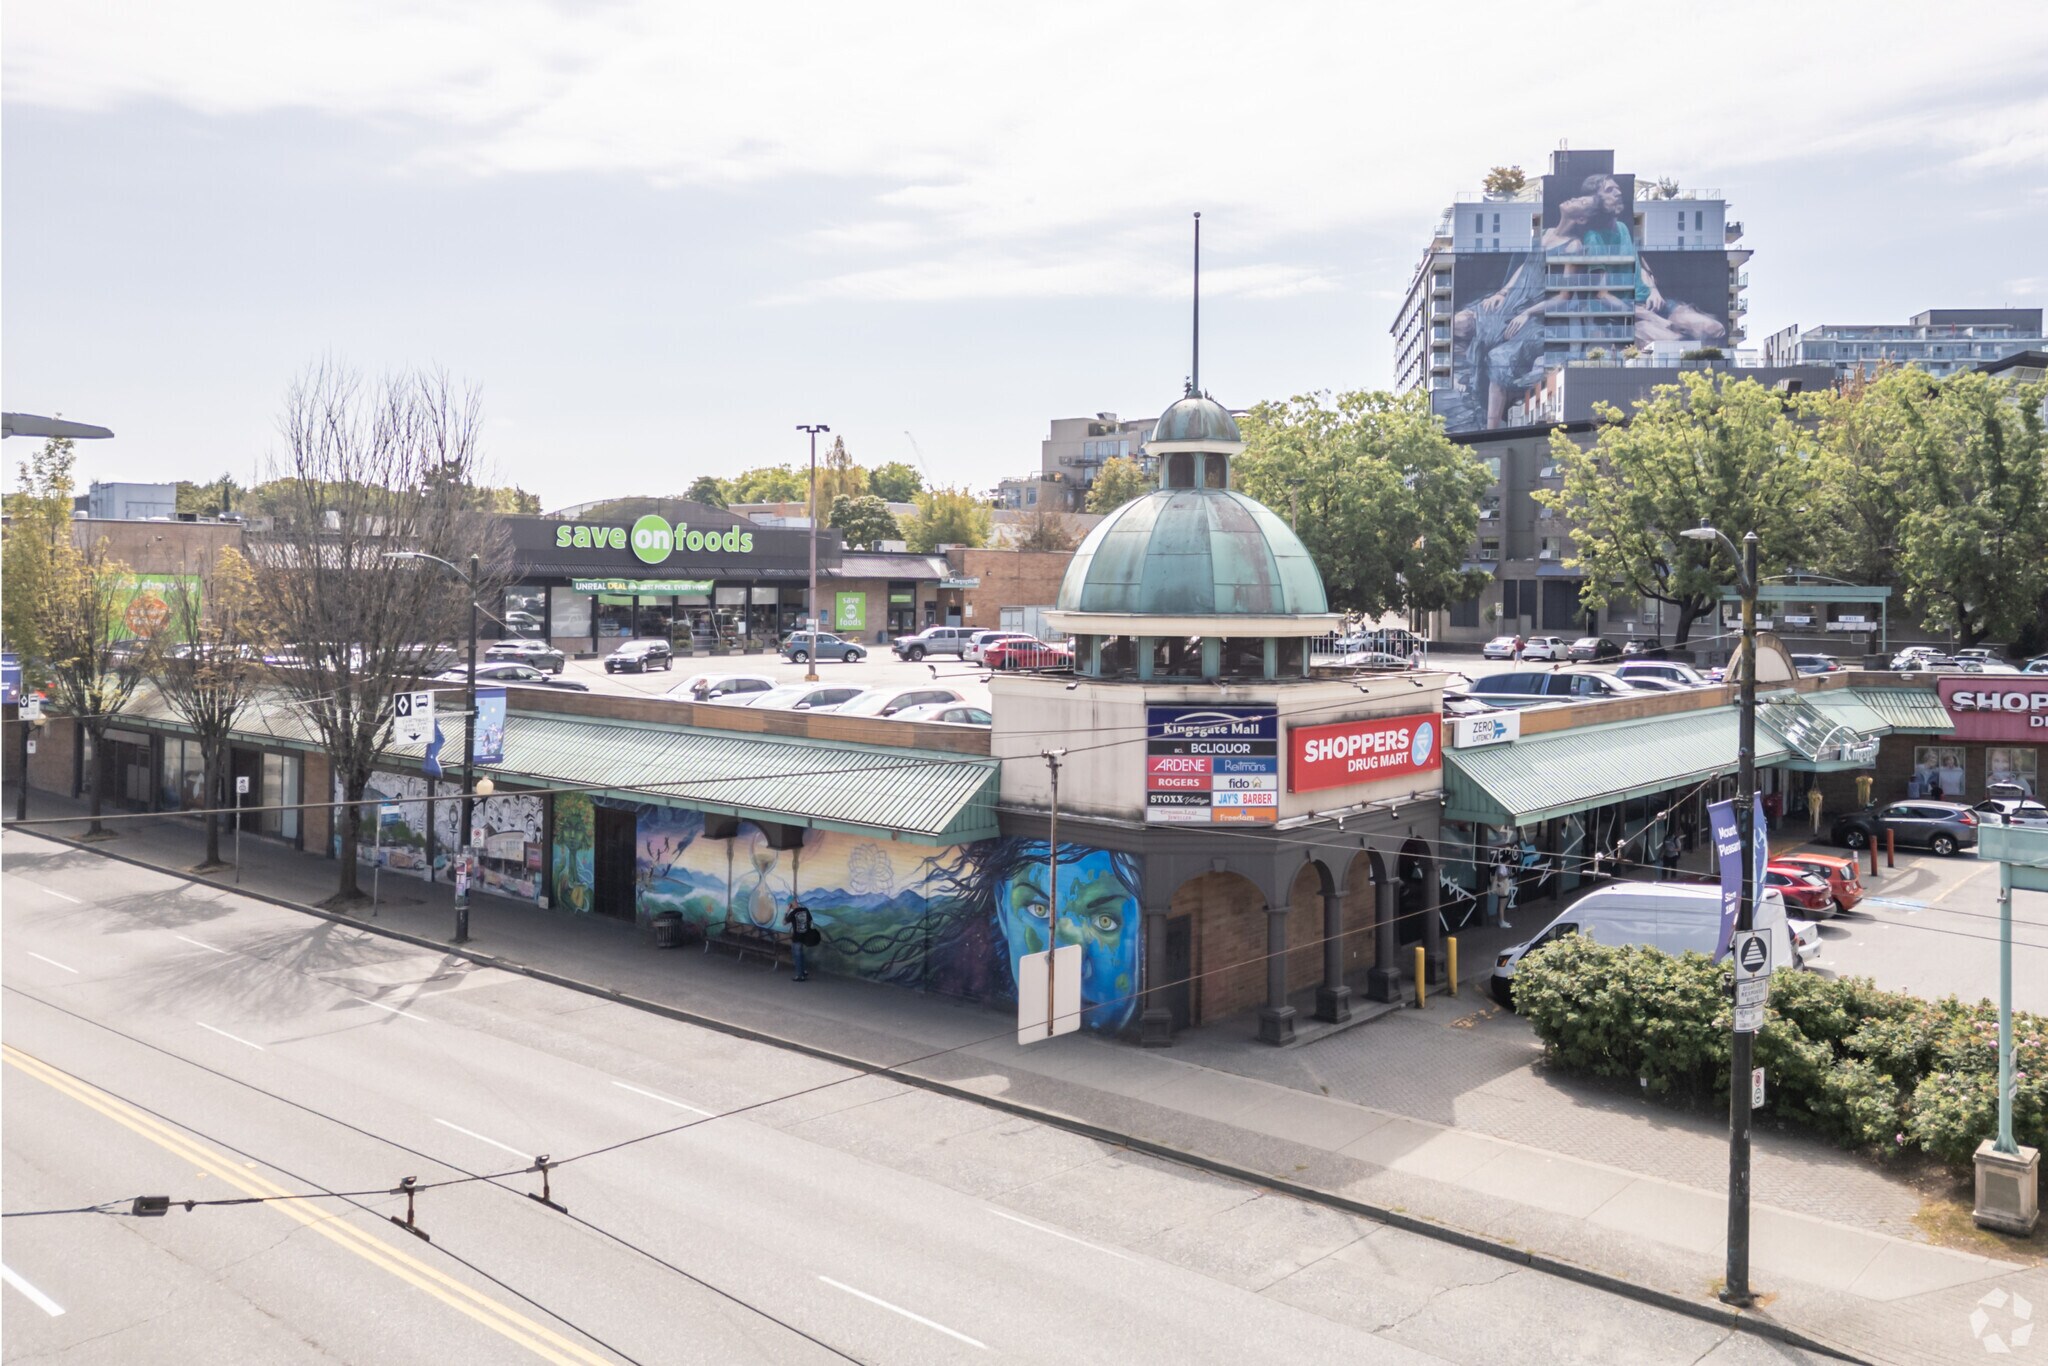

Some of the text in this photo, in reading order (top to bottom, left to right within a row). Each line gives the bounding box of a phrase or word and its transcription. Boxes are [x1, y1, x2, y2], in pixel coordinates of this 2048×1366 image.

[556, 522, 753, 553] save on foods
[575, 582, 607, 590] UNREAL
[607, 582, 627, 590] DEAL
[840, 617, 862, 626] foods
[1164, 723, 1260, 737] Kingsgate Mall
[1473, 721, 1493, 734] ZERO
[1472, 734, 1492, 743] LATENCY
[1190, 743, 1251, 754] BCLIQUOR
[1304, 728, 1409, 763] SHOPPERS
[1153, 759, 1205, 772] ARDENE
[1224, 760, 1266, 772] Reitmans
[1348, 751, 1409, 773] DRUG MART
[1158, 778, 1200, 787] ROGERS
[1228, 778, 1250, 789] fido
[1150, 795, 1183, 803] STOXX
[1218, 793, 1272, 805] JAY'S BARBER
[1718, 824, 1738, 840] Mount
